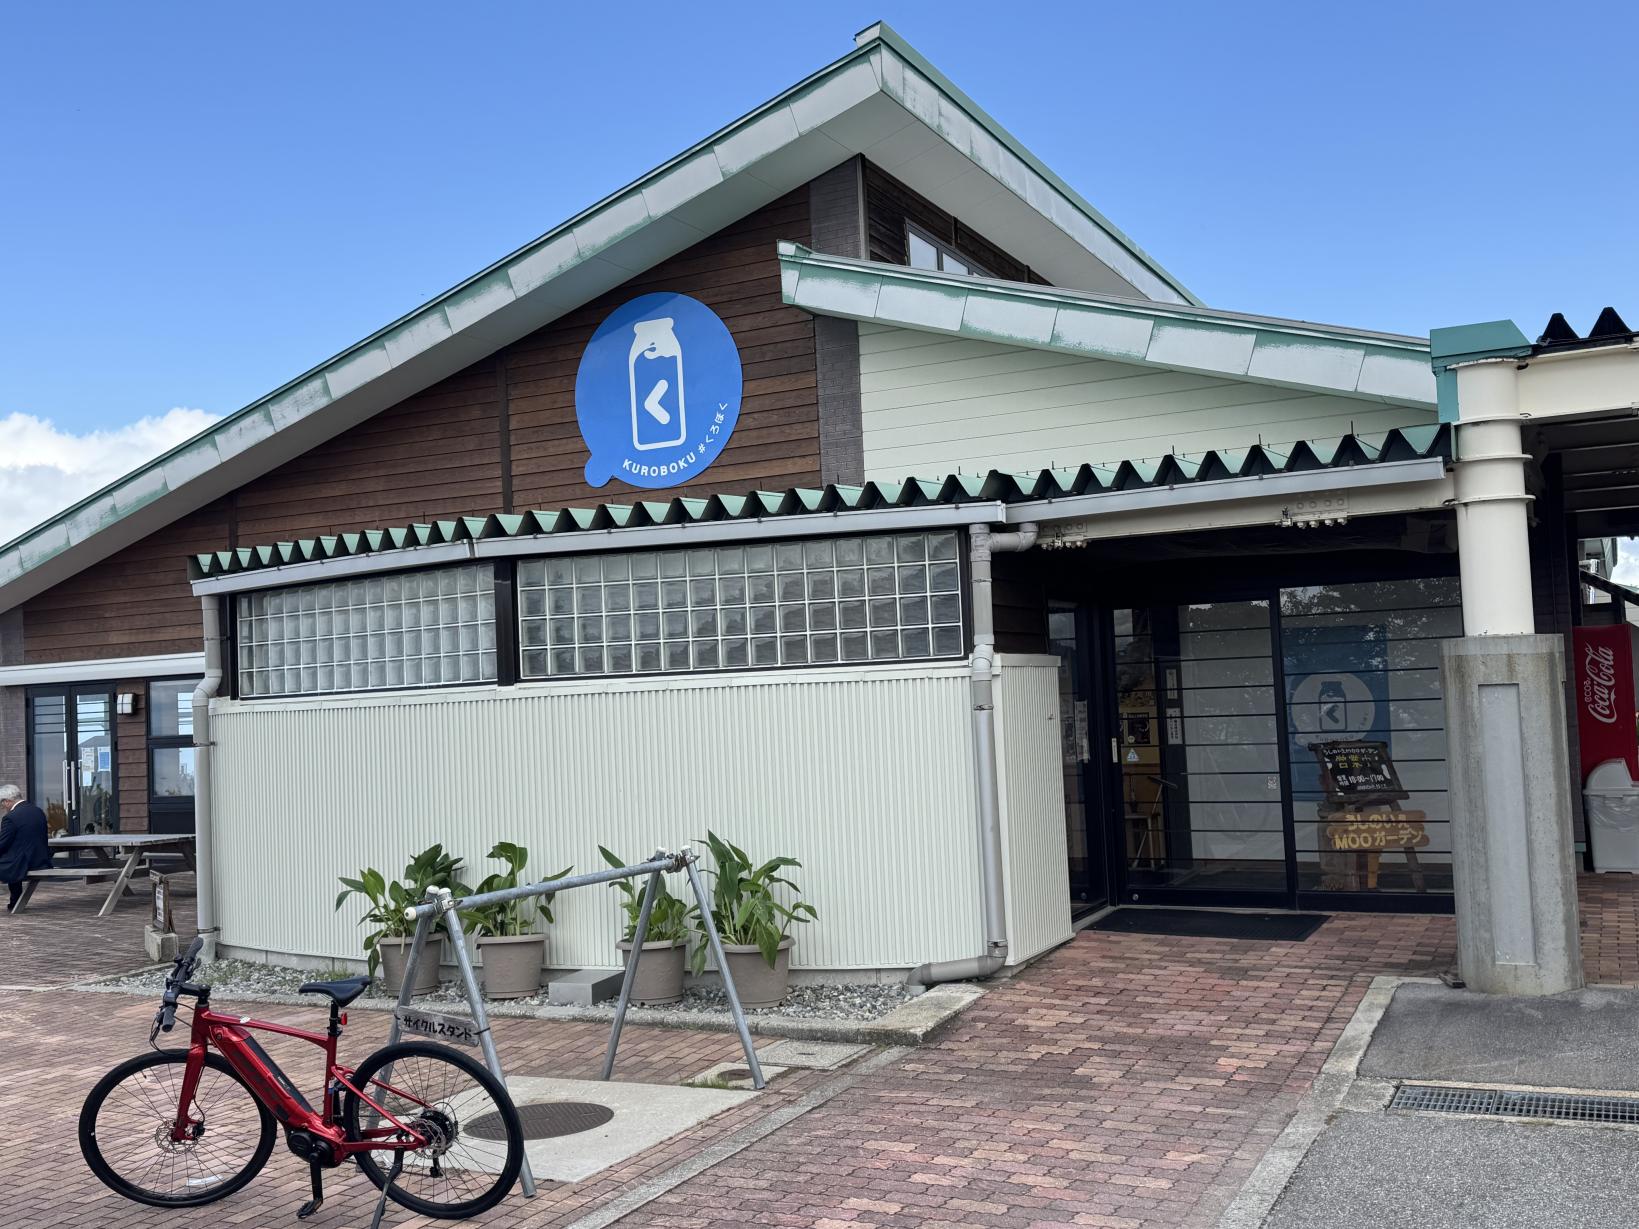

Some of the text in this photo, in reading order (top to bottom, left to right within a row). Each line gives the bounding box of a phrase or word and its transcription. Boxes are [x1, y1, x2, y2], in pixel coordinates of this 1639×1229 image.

[622, 402, 728, 476] KUROBOKU #くろぼく
[1585, 642, 1617, 723] Coca-Cola
[1345, 814, 1409, 831] うしのいえ
[403, 1015, 473, 1041] サイクルスタンド
